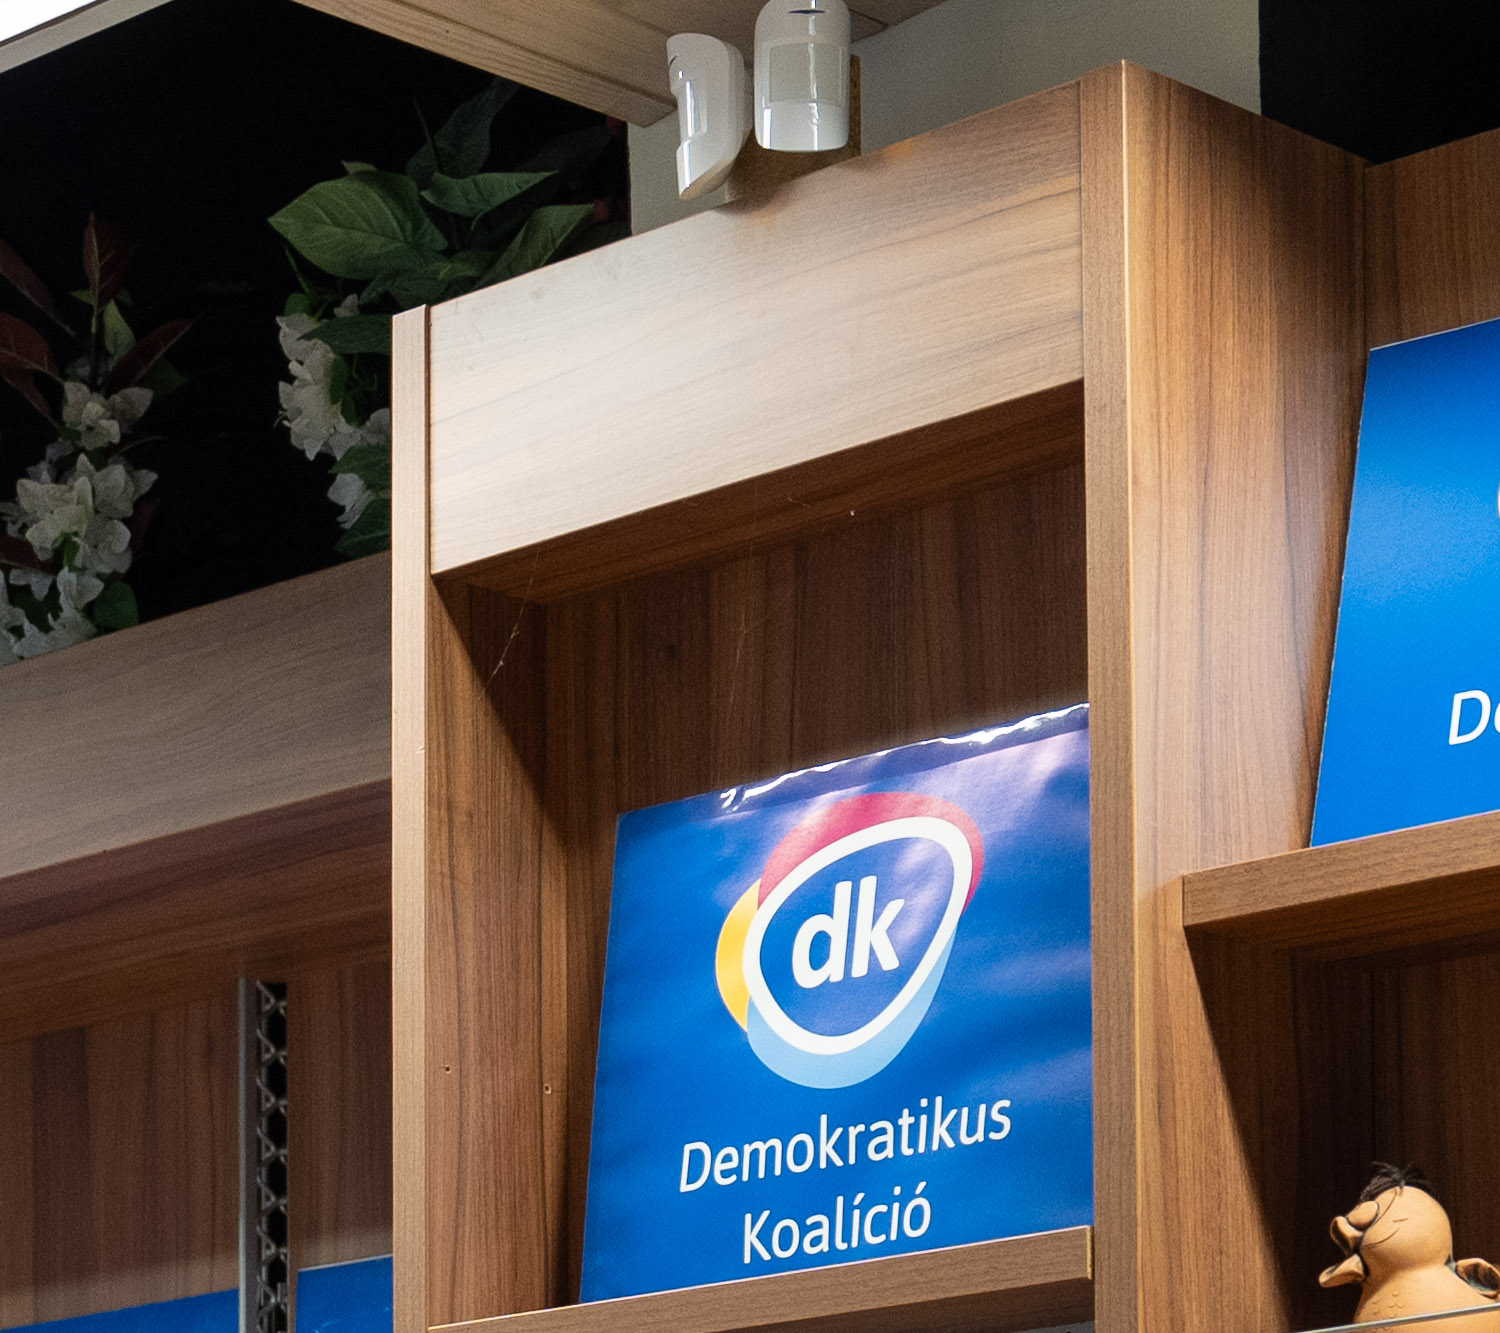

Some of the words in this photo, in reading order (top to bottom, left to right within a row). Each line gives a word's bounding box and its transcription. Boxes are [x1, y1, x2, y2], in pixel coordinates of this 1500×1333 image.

[791, 875, 906, 990] dk
[679, 1096, 1012, 1193] Demokratikus
[743, 1181, 932, 1264] Koalíció
